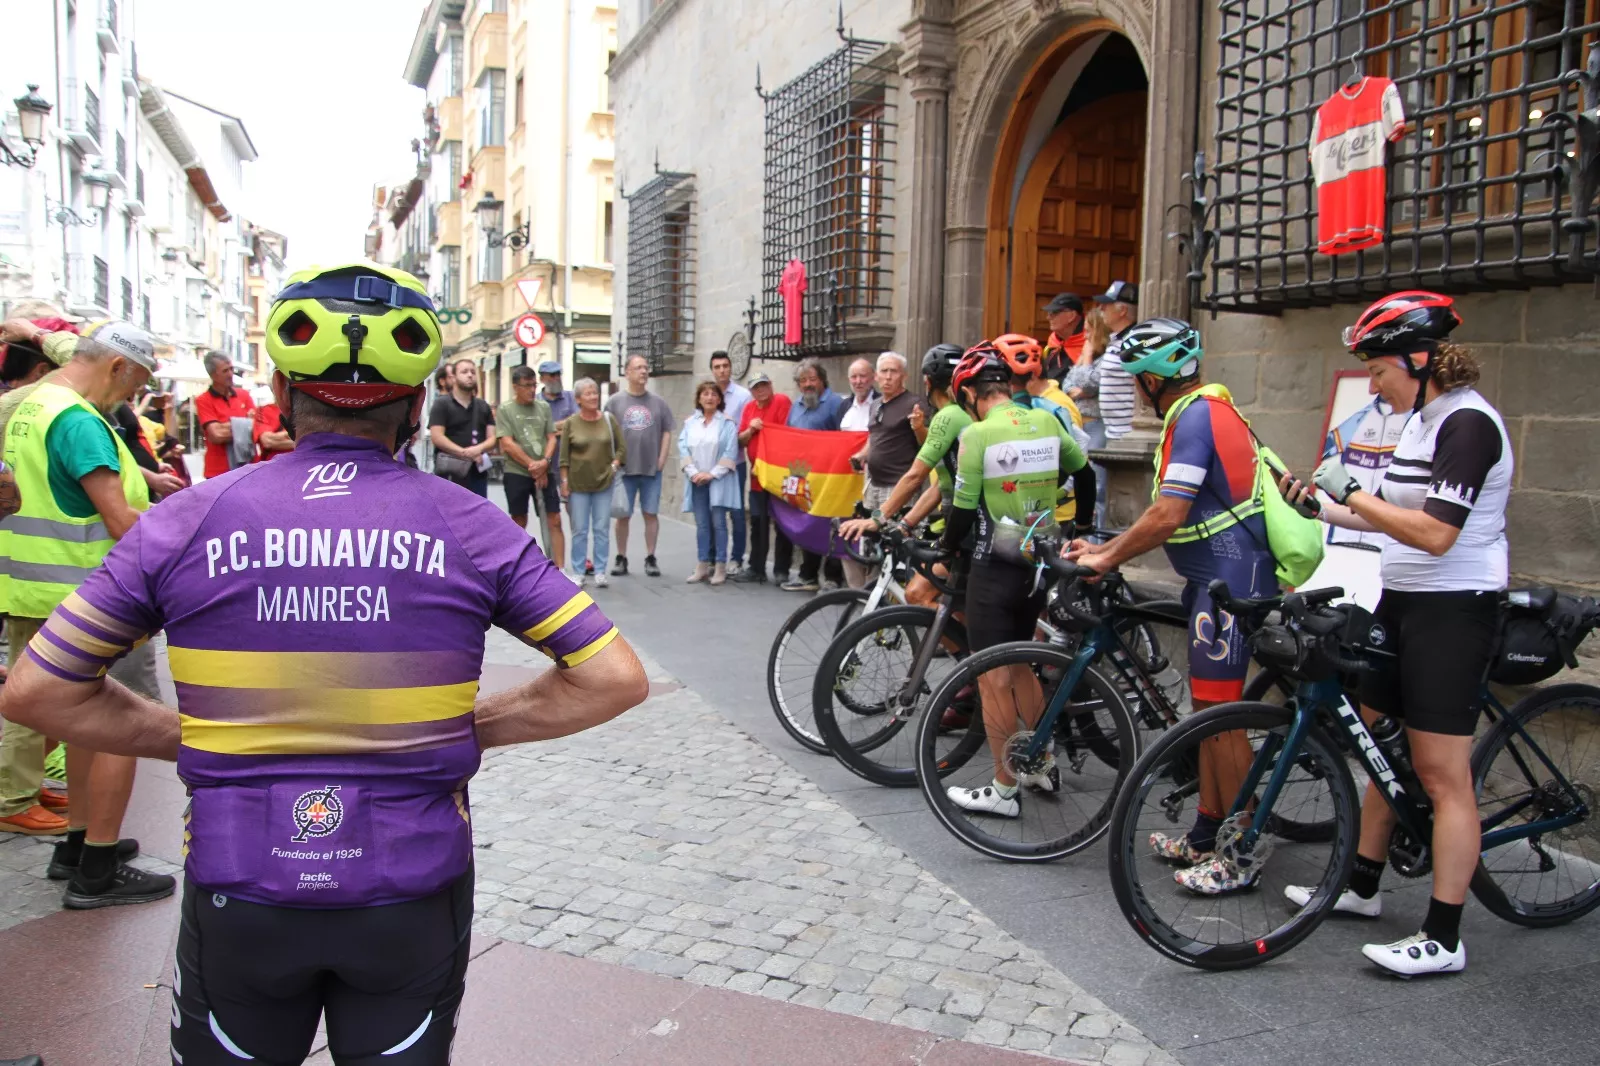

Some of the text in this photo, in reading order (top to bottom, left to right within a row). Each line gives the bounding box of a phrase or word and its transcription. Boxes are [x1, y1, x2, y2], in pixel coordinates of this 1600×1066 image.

[1021, 446, 1054, 457] RENAULT
[302, 461, 358, 492] 100
[256, 585, 391, 622] MANRESA
[1337, 694, 1406, 799] TREK
[271, 847, 363, 860] Fundada el 1926
[299, 872, 332, 882] tactic
[296, 881, 339, 891] projects
